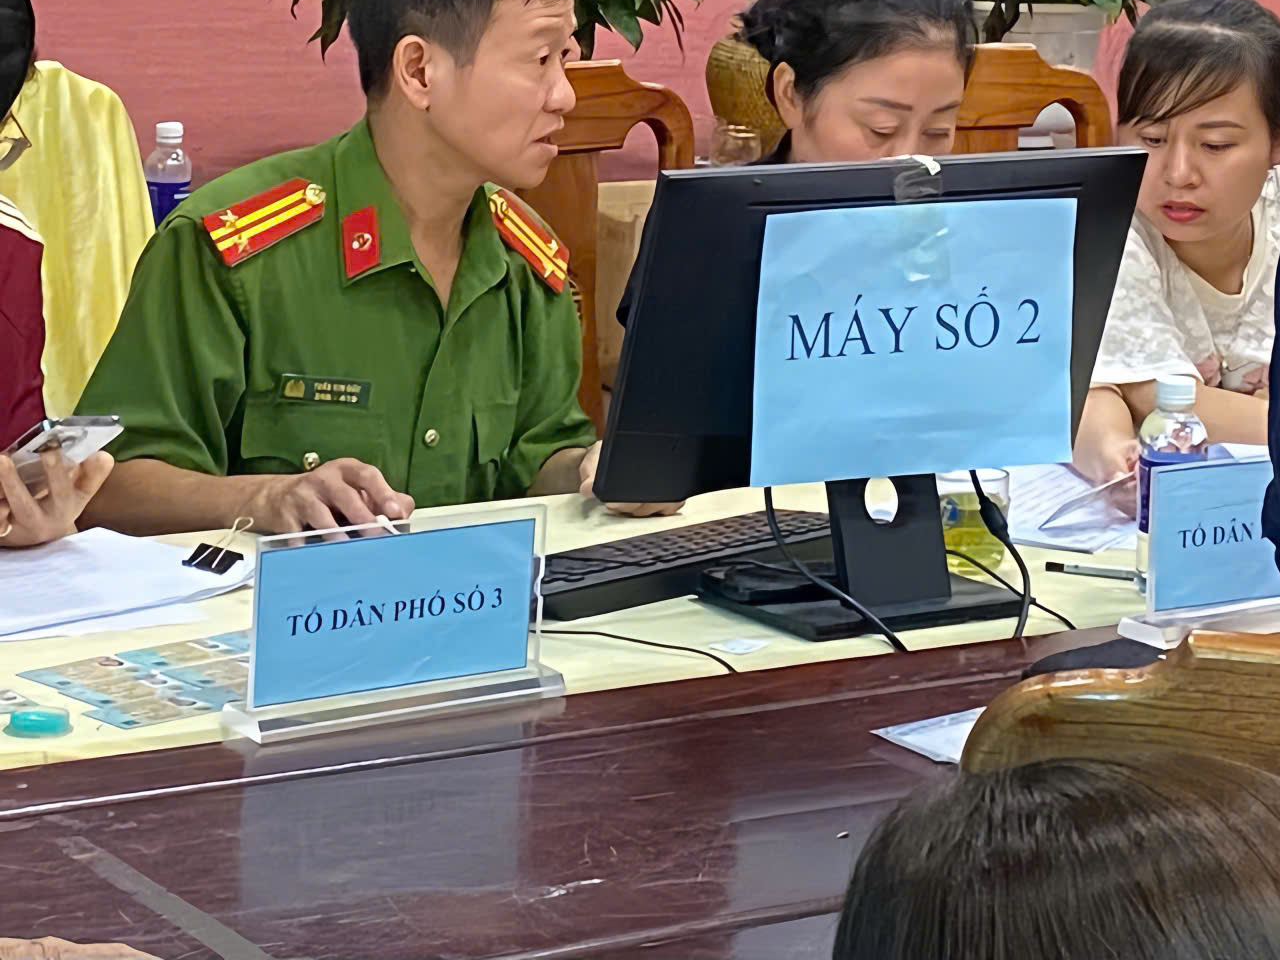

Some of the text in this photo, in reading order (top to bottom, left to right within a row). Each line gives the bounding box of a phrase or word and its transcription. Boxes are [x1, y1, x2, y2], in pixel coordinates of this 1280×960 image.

[785, 286, 1042, 361] MÁY SỐ 2
[331, 599, 386, 631] DÂN
[491, 587, 502, 609] 3
